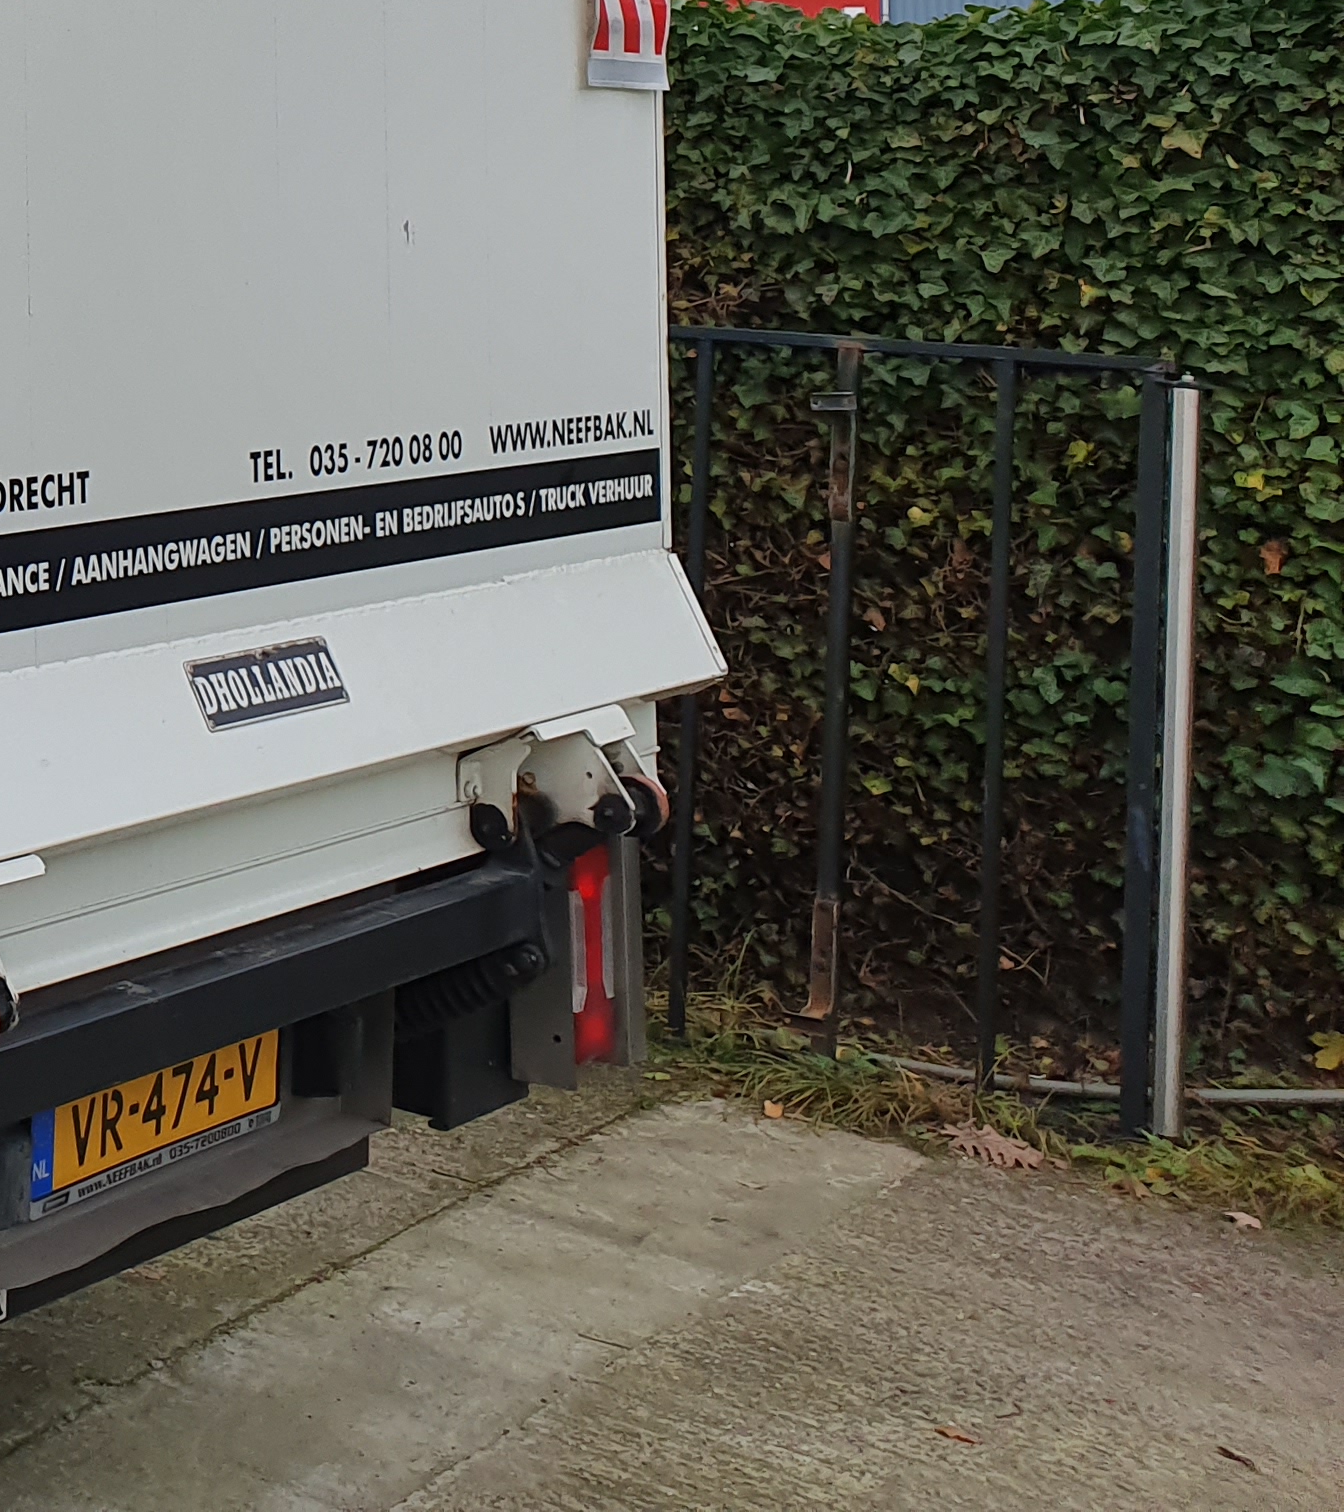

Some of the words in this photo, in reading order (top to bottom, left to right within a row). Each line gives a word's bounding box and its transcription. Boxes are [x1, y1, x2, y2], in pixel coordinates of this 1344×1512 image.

[249, 448, 293, 483] TEL.
[310, 442, 349, 477] 035
[366, 436, 403, 469] 720
[409, 433, 433, 464] 08
[438, 430, 463, 461] 00
[489, 409, 654, 454] WWW.NEEFBAK.NL
[71, 531, 251, 586] AANHANGWAGEN
[375, 509, 398, 538] EN
[539, 483, 586, 513] TRUCK
[588, 474, 654, 505] VERHUUR
[192, 652, 342, 716] DHOLLANDIA
[72, 1037, 263, 1168] VR-474-V
[32, 1159, 50, 1183] NL
